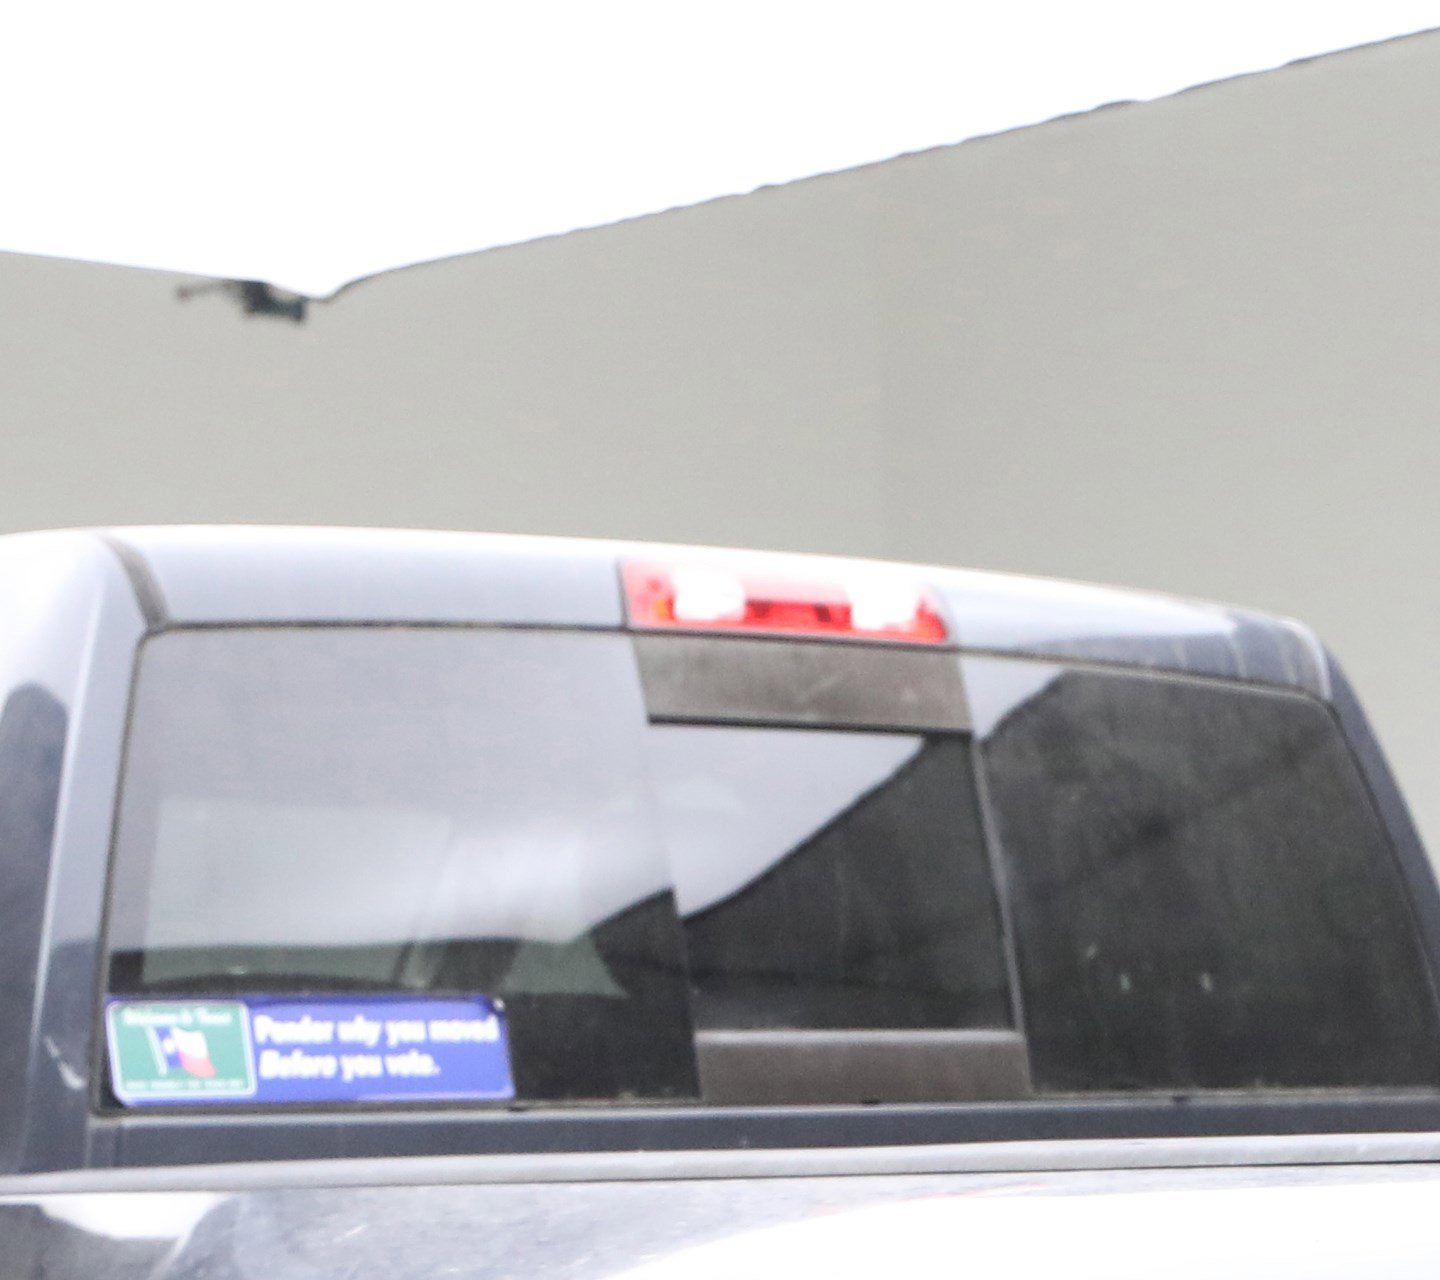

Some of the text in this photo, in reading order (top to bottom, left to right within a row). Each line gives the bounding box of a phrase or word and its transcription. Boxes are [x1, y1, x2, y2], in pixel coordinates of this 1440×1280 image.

[337, 1013, 381, 1047] why
[385, 1020, 427, 1047] you
[260, 1050, 337, 1078] Before
[339, 1054, 383, 1082] you
